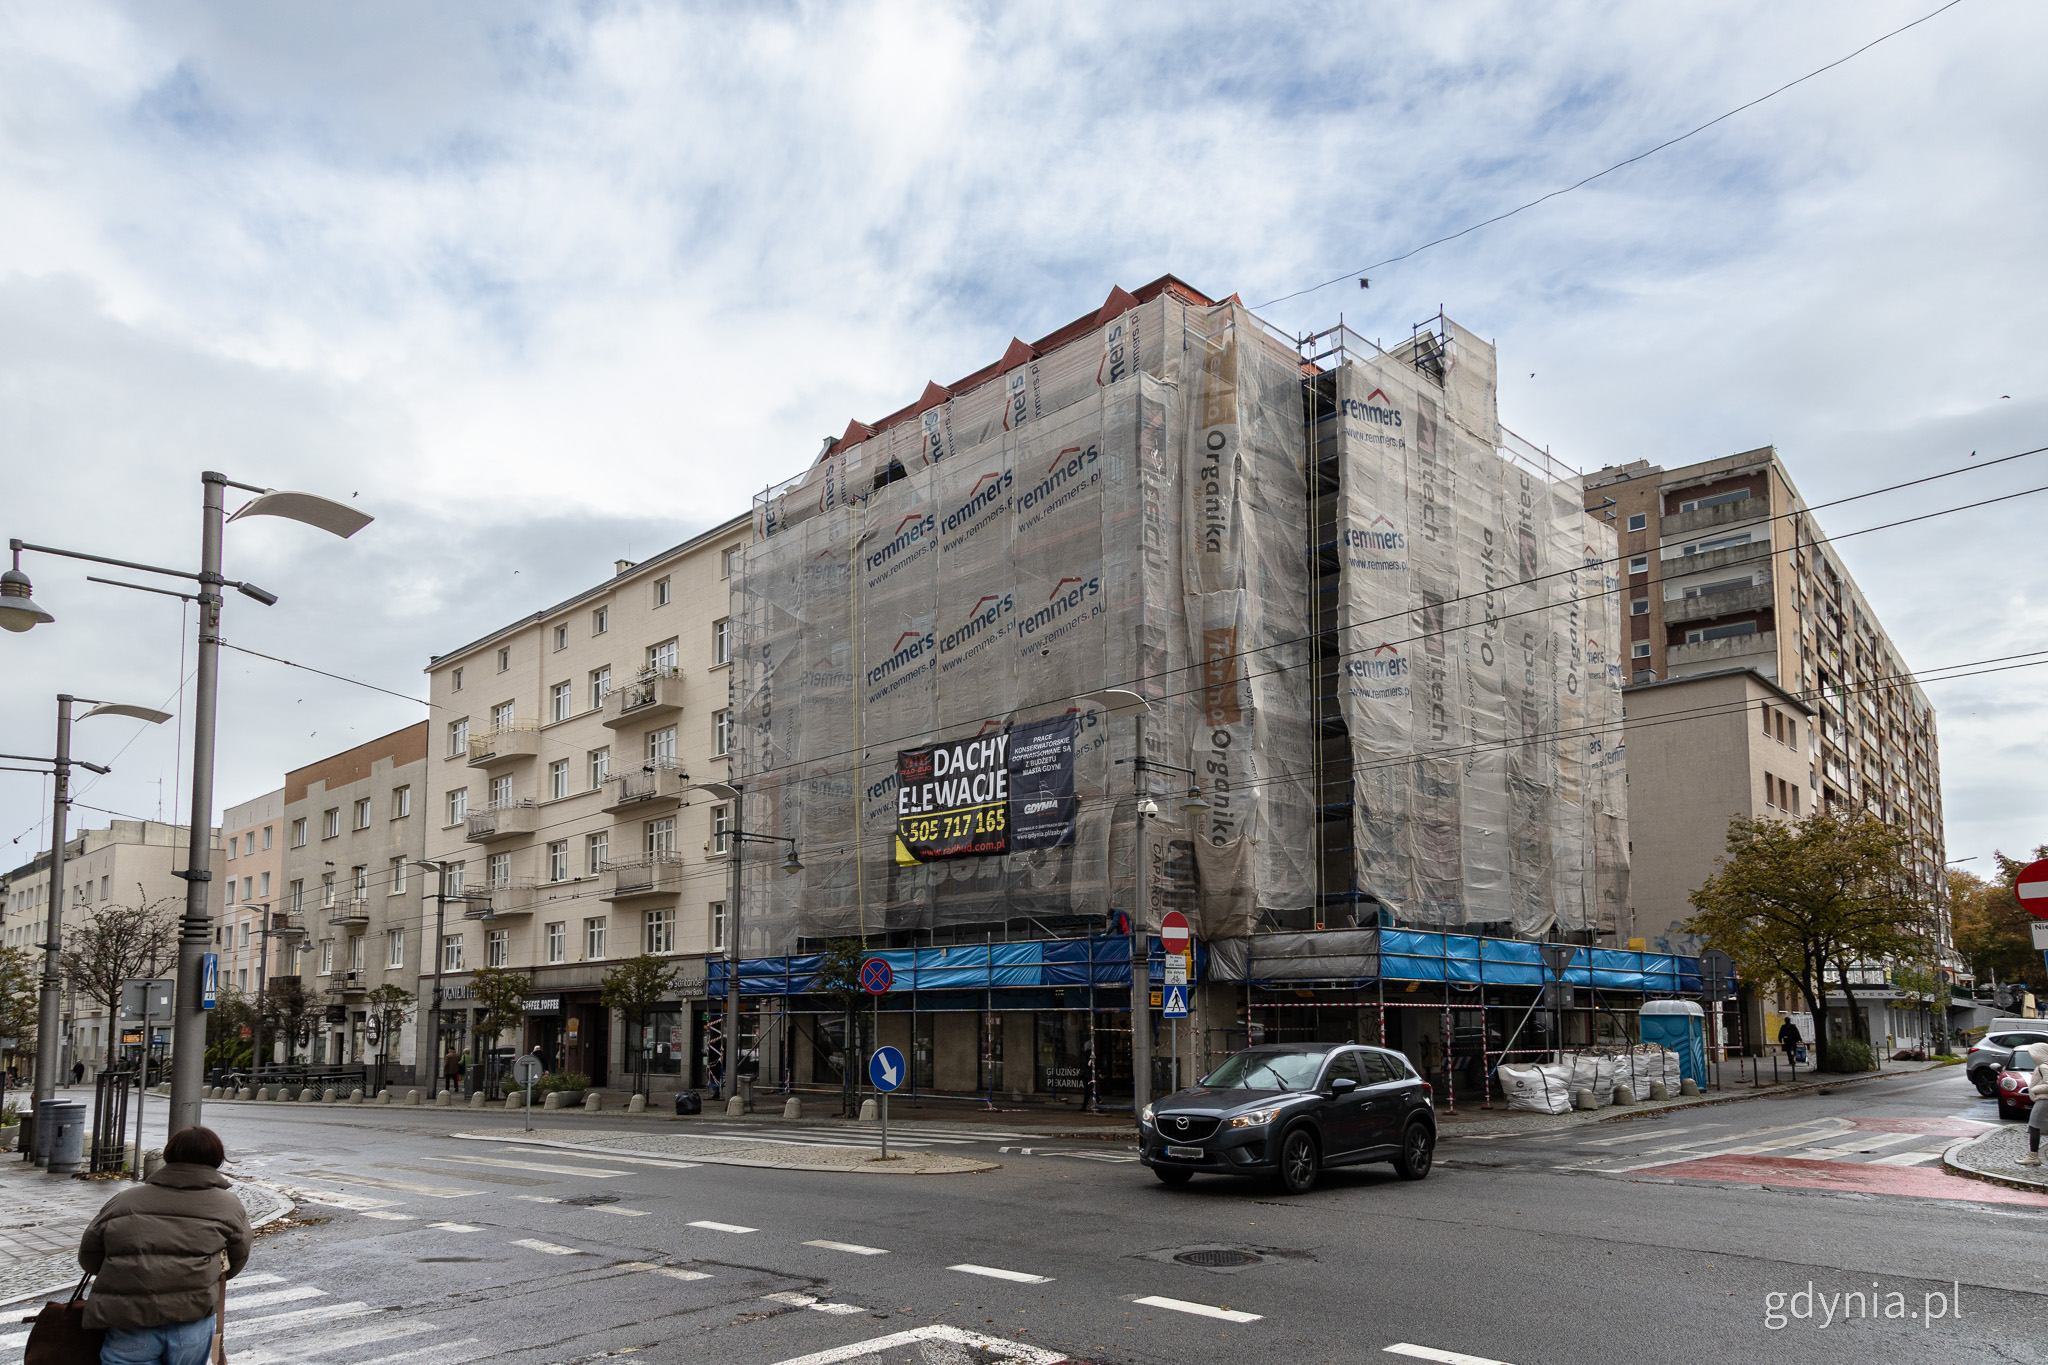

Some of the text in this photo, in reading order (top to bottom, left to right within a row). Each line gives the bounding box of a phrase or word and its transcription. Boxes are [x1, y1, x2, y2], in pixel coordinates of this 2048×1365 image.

[1341, 398, 1402, 427] remmers
[940, 469, 1013, 535] remmers
[1016, 444, 1099, 514] remmers
[1018, 468, 1102, 533] www.remmers.pl
[1201, 430, 1226, 553] Organika
[866, 514, 935, 572] remmers
[868, 535, 939, 588] www.remmers.pl
[1343, 529, 1404, 550] remmers
[1018, 576, 1100, 638] remmers
[1480, 528, 1498, 667] Organika
[940, 593, 1013, 654] remmers
[942, 616, 1017, 672] www.remmers.pl
[1020, 601, 1103, 657] www.remmers.pl
[1567, 571, 1581, 695] Organika
[868, 633, 935, 687] remmers
[869, 653, 938, 704] www.remmers.pl
[1208, 637, 1230, 720] Termo
[1345, 656, 1408, 678] remmers
[1468, 658, 1476, 708] System
[1551, 684, 1559, 731] System
[933, 734, 1009, 777] DACHY
[1014, 737, 1070, 754] KONSERWATORSKIE
[1030, 755, 1057, 767] BUDŻETU
[1033, 734, 1053, 743] PRACE
[899, 769, 1008, 814] ELEWACJE
[1042, 763, 1061, 773] GDYNI
[909, 809, 1006, 842] 505 717 165
[1024, 800, 1058, 815] GDYNIA
[920, 838, 1006, 857] www.radbud.com.pl
[1150, 843, 1162, 915] CAPAROL
[443, 986, 466, 1000] OGNIEM
[522, 999, 559, 1011] COFFEE TOFFEE
[674, 978, 704, 986] Santander
